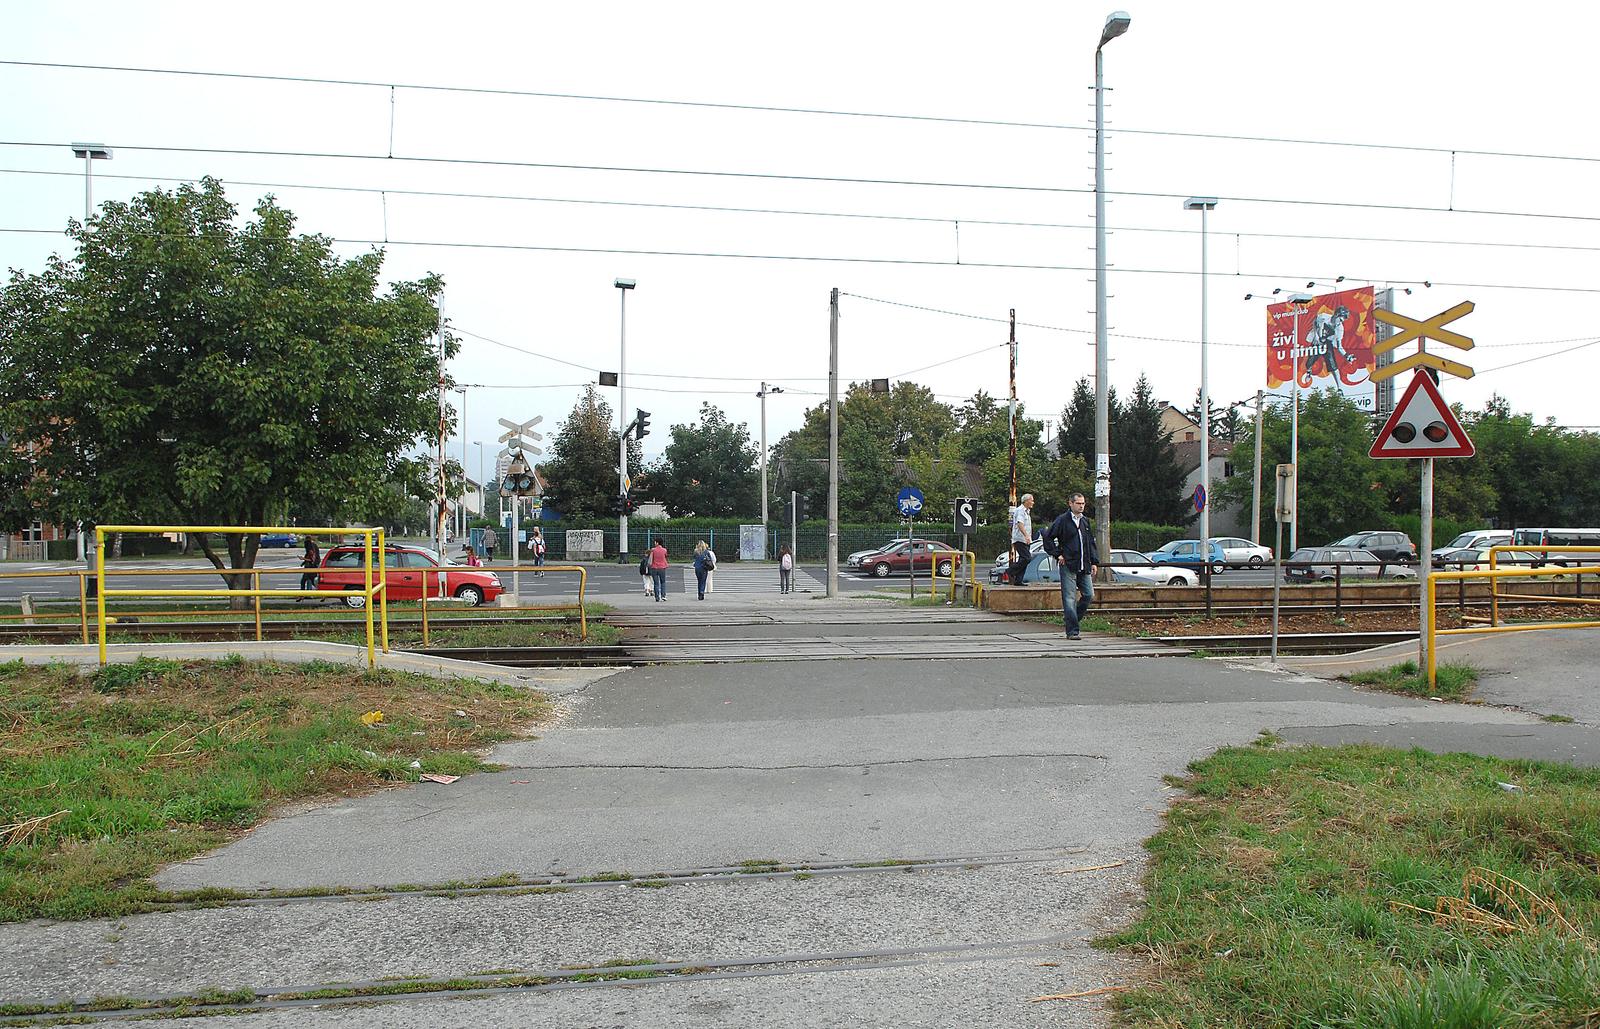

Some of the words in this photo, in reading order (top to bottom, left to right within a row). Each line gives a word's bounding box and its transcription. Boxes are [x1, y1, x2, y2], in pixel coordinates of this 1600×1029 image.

[1273, 312, 1281, 320] vip
[1277, 350, 1286, 360] u
[1357, 396, 1371, 407] vip
[960, 503, 973, 527] S
